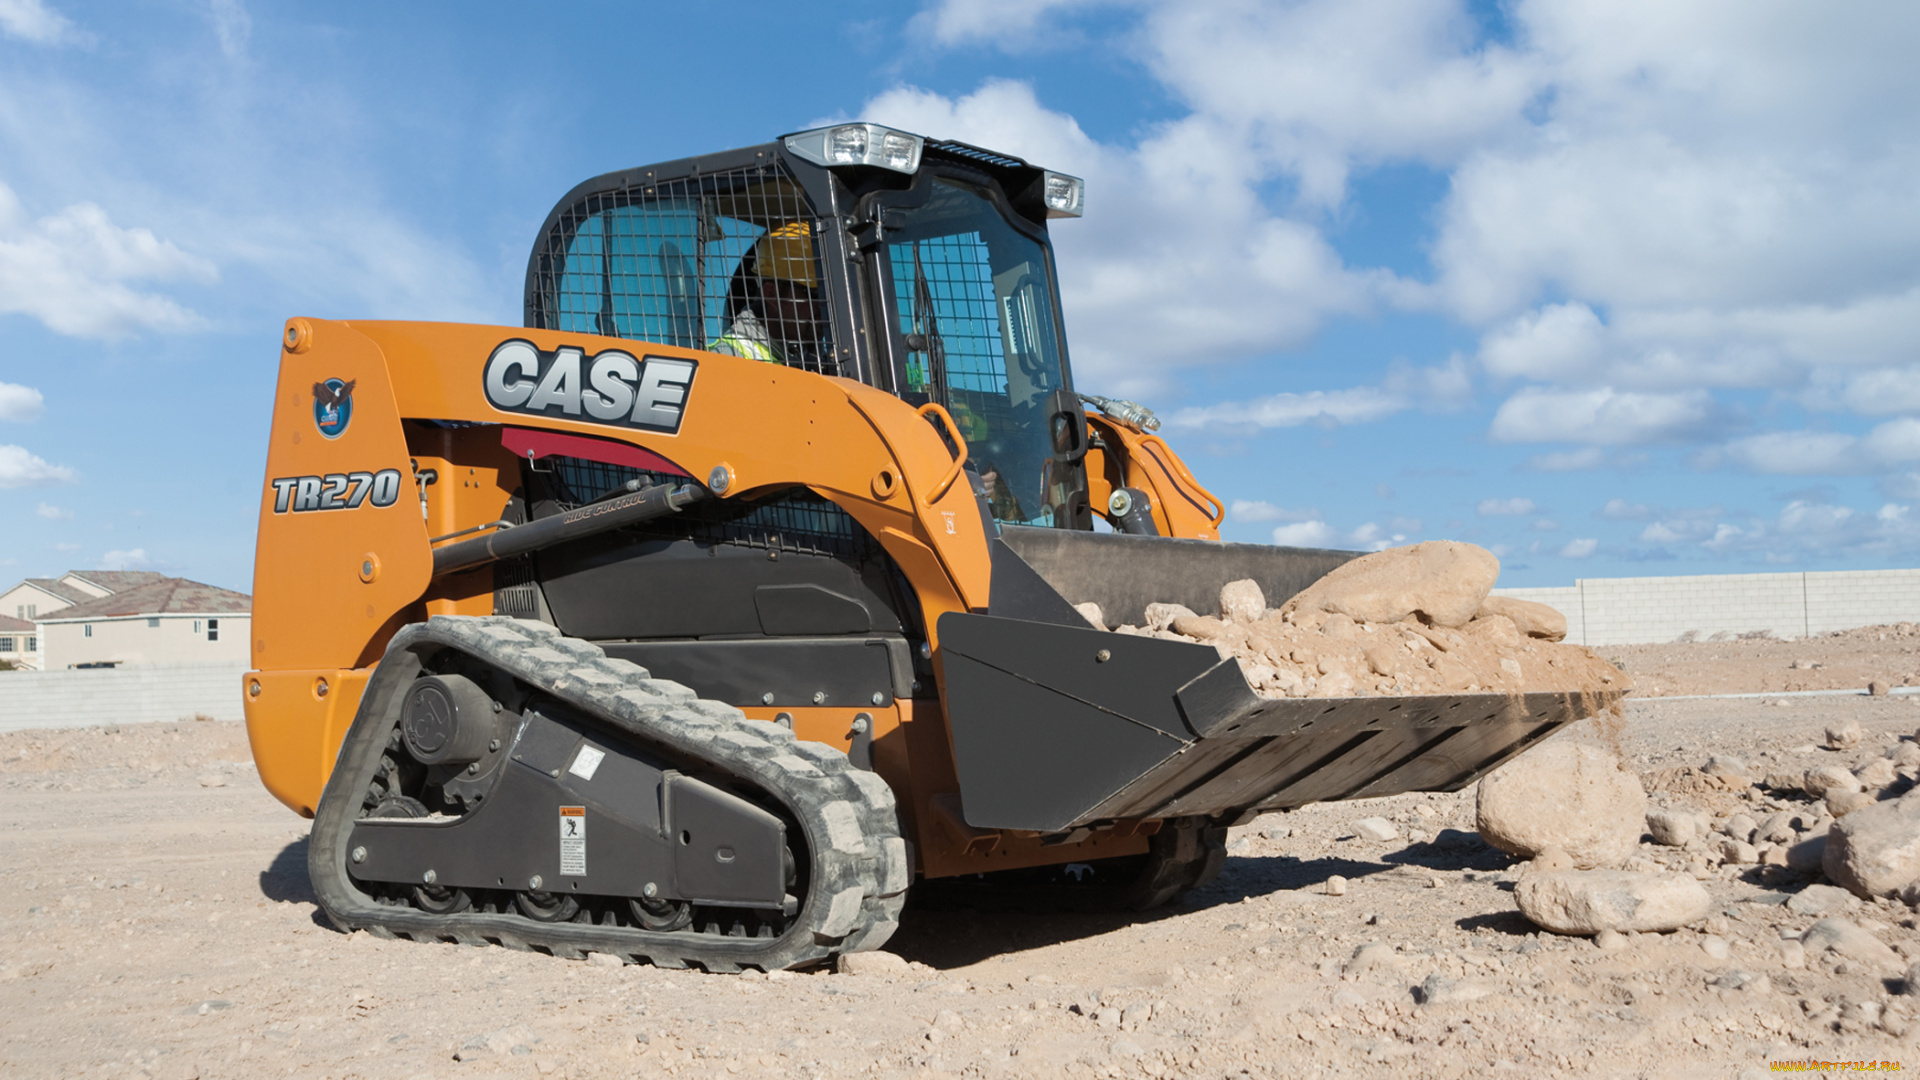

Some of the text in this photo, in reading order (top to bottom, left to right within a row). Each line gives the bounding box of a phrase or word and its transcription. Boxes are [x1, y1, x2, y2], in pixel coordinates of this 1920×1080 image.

[485, 340, 697, 430] CASE
[272, 469, 401, 513] TR270
[593, 493, 647, 517] CONTROL
